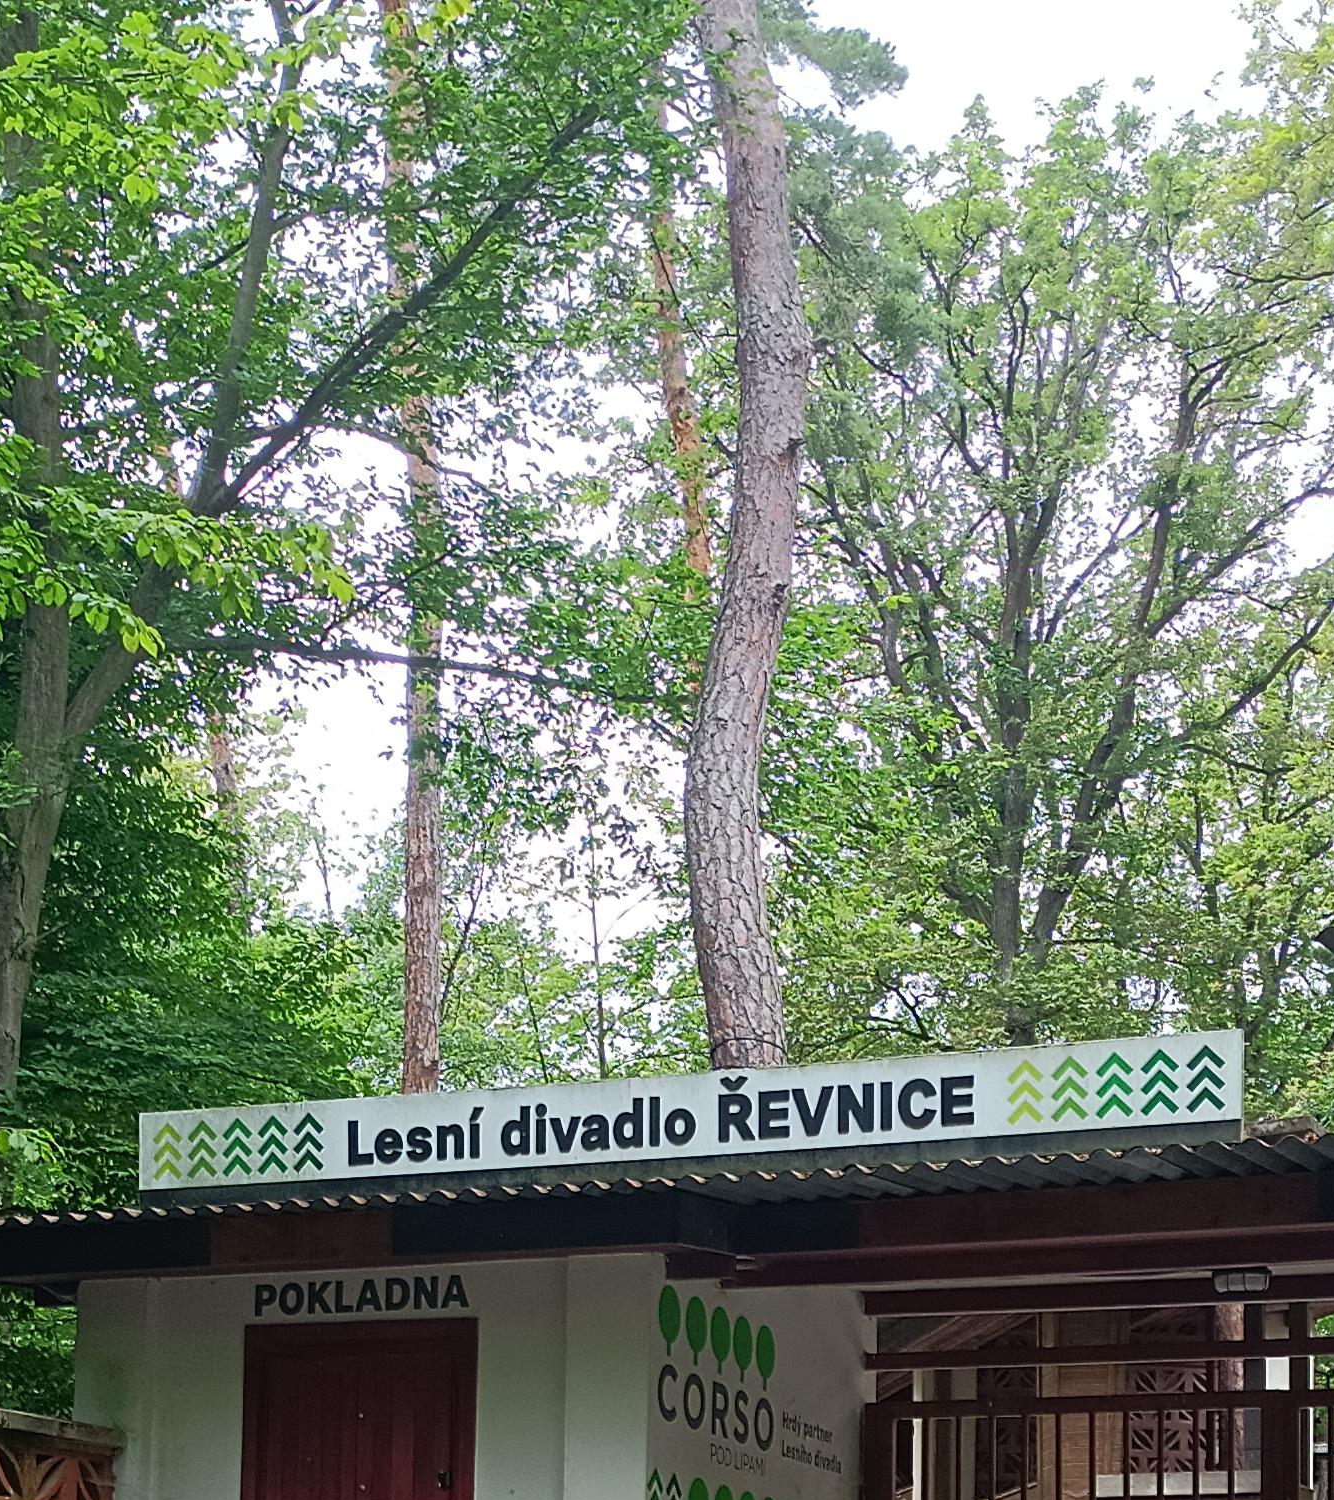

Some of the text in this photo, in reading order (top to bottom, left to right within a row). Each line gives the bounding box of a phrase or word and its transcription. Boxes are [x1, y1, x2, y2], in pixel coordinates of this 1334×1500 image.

[347, 1075, 975, 1167] Lesní divadlo ŘEVNICE
[254, 1275, 469, 1317] POKLADNA
[657, 1364, 775, 1452] CORSO
[782, 1411, 833, 1445] Hrdý partner
[710, 1443, 766, 1478] POD LIPAMI
[781, 1439, 842, 1474] Lesního divadla
